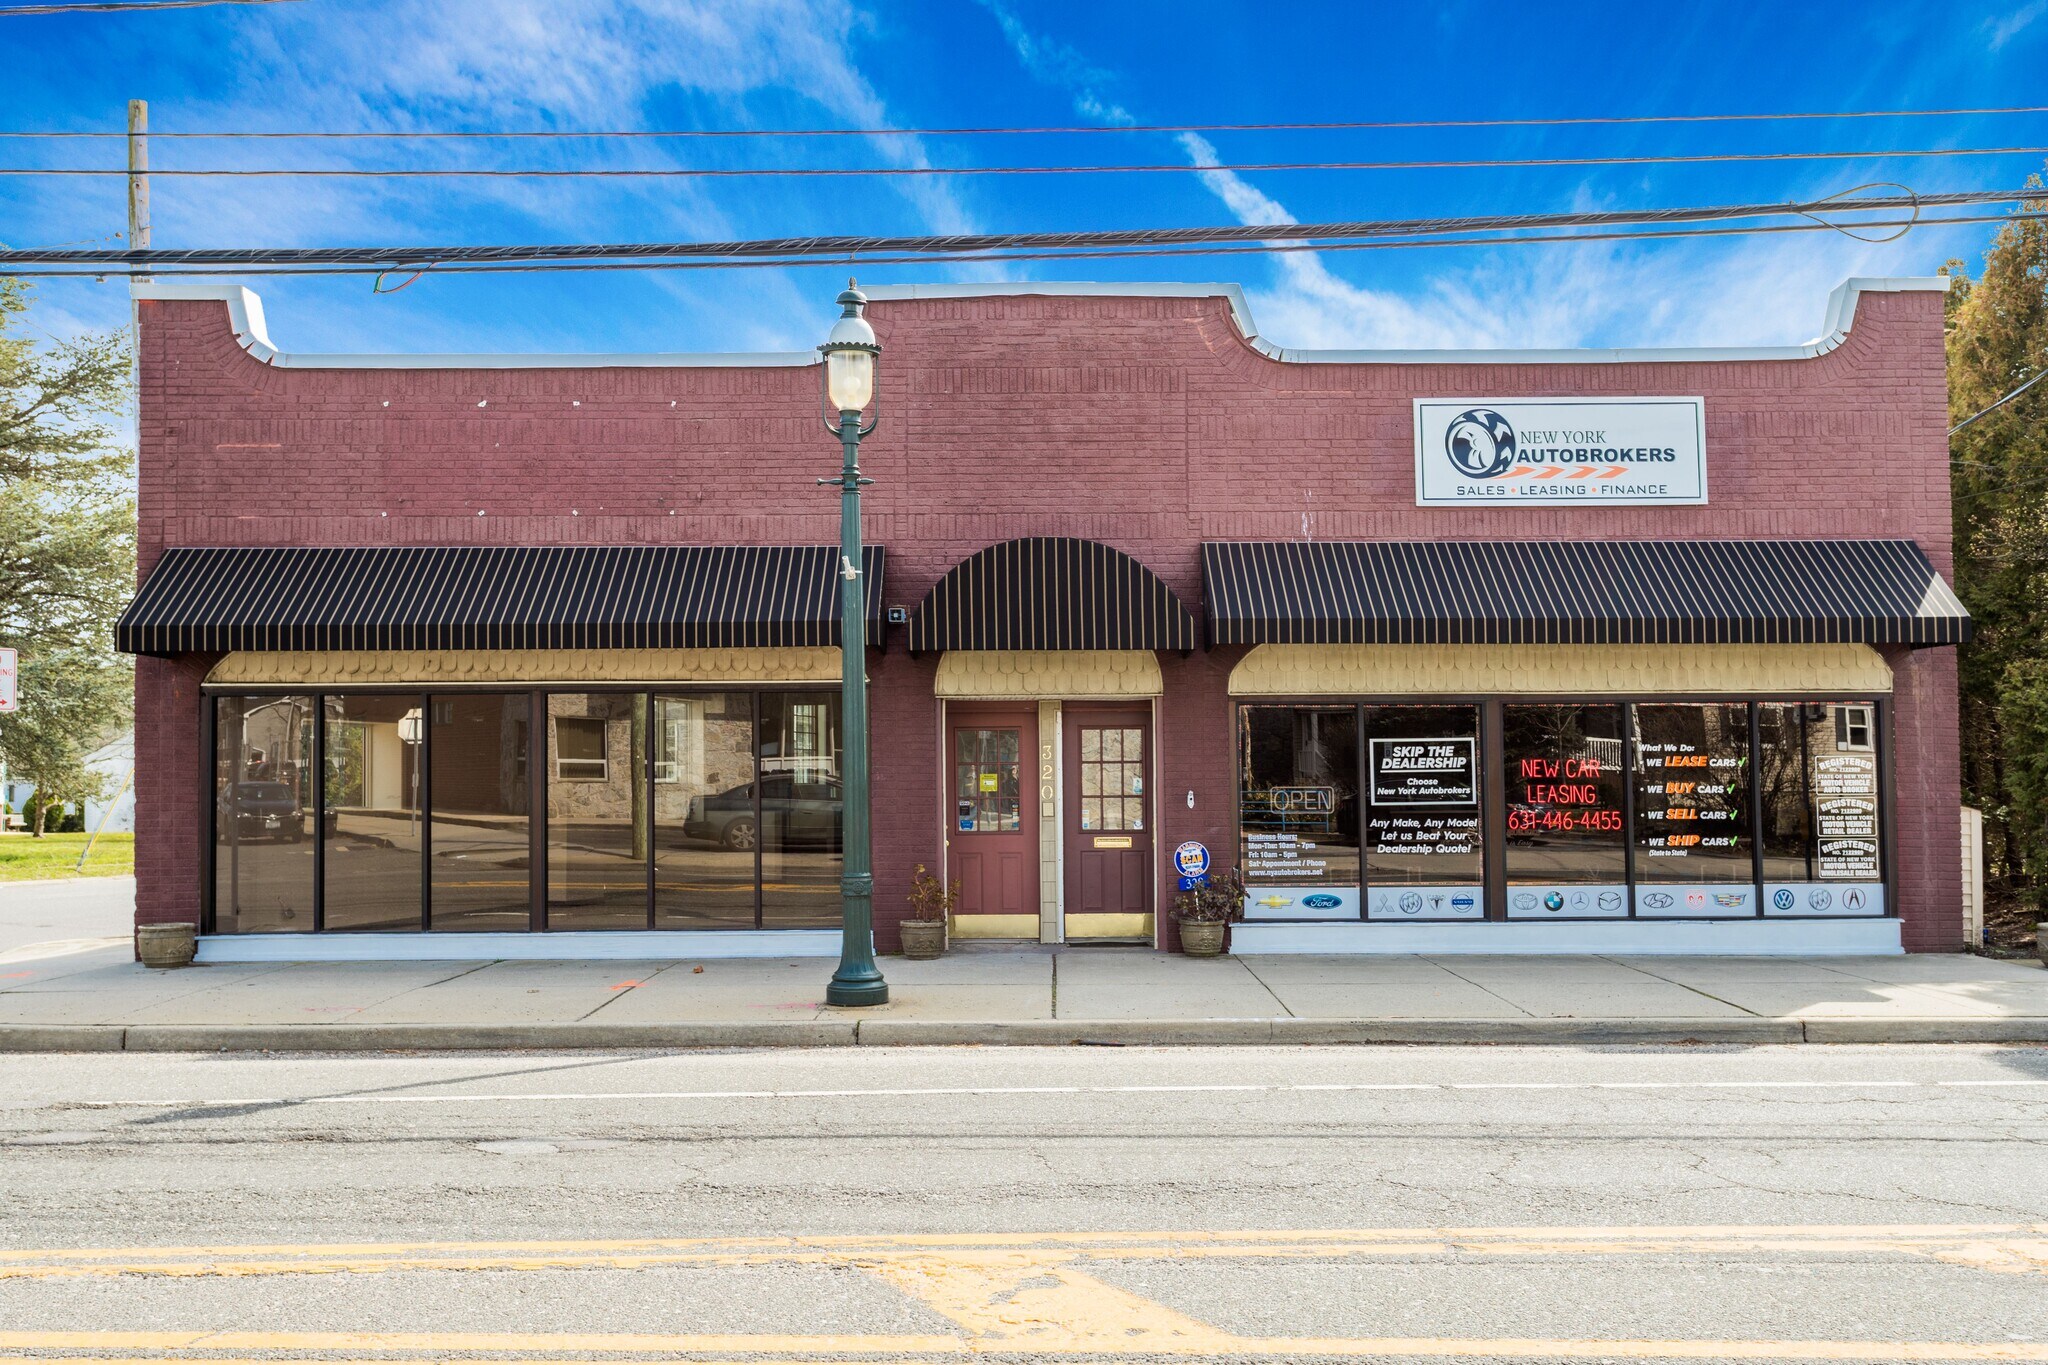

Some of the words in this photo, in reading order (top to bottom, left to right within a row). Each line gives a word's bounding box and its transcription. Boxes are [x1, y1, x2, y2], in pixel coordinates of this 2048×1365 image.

[1520, 431, 1558, 444] NEW
[1565, 430, 1606, 443] YORK
[1517, 448, 1676, 463] AUTOBROKERS
[1457, 485, 1505, 496] SALES
[1520, 485, 1586, 495] LEASING
[1601, 484, 1668, 494] FINANCE
[1392, 746, 1425, 758] SKIP
[1428, 746, 1455, 757] THE
[1640, 744, 1661, 752] What
[1664, 744, 1677, 752] We
[1680, 744, 1695, 752] Do:
[1381, 757, 1467, 769] DEALERSHIP
[1646, 759, 1662, 767] WE
[1664, 756, 1708, 767] LEASE
[1709, 759, 1736, 767] CARS
[1818, 757, 1873, 770] REGISTERED
[1041, 745, 1053, 800] 320
[1521, 759, 1560, 778] NEW
[1565, 759, 1600, 778] CAR
[1377, 787, 1395, 795] New
[1398, 787, 1417, 795] York
[1419, 786, 1471, 795] Autobrokers
[1527, 784, 1596, 804] LEASING
[1647, 785, 1663, 793] WE
[1665, 782, 1695, 794] BUY
[1697, 785, 1724, 793] CARS
[1274, 790, 1331, 810] OPEN
[1820, 798, 1874, 812] REGISTERED
[1648, 811, 1664, 819] WE
[1666, 808, 1698, 820] SELL
[1700, 811, 1727, 819] CARS
[1370, 819, 1390, 829] Any
[1393, 818, 1421, 828] Make,
[1424, 819, 1444, 829] Any
[1447, 818, 1478, 827] Model
[1508, 811, 1622, 830] 631-446-4455
[1381, 831, 1398, 840] Let
[1416, 831, 1441, 840] Beat
[1444, 831, 1468, 840] Your
[1649, 838, 1665, 846] WE
[1667, 835, 1700, 846] SHIP
[1702, 838, 1729, 846] CARS
[1302, 842, 1316, 850] 7pm
[1377, 844, 1433, 855] Dealership
[1436, 844, 1471, 853] Quote!
[1821, 840, 1876, 854] REGISTERED
[1283, 851, 1298, 859] 5pm
[1262, 860, 1301, 868] Appointment
[1310, 896, 1334, 907] Ford
